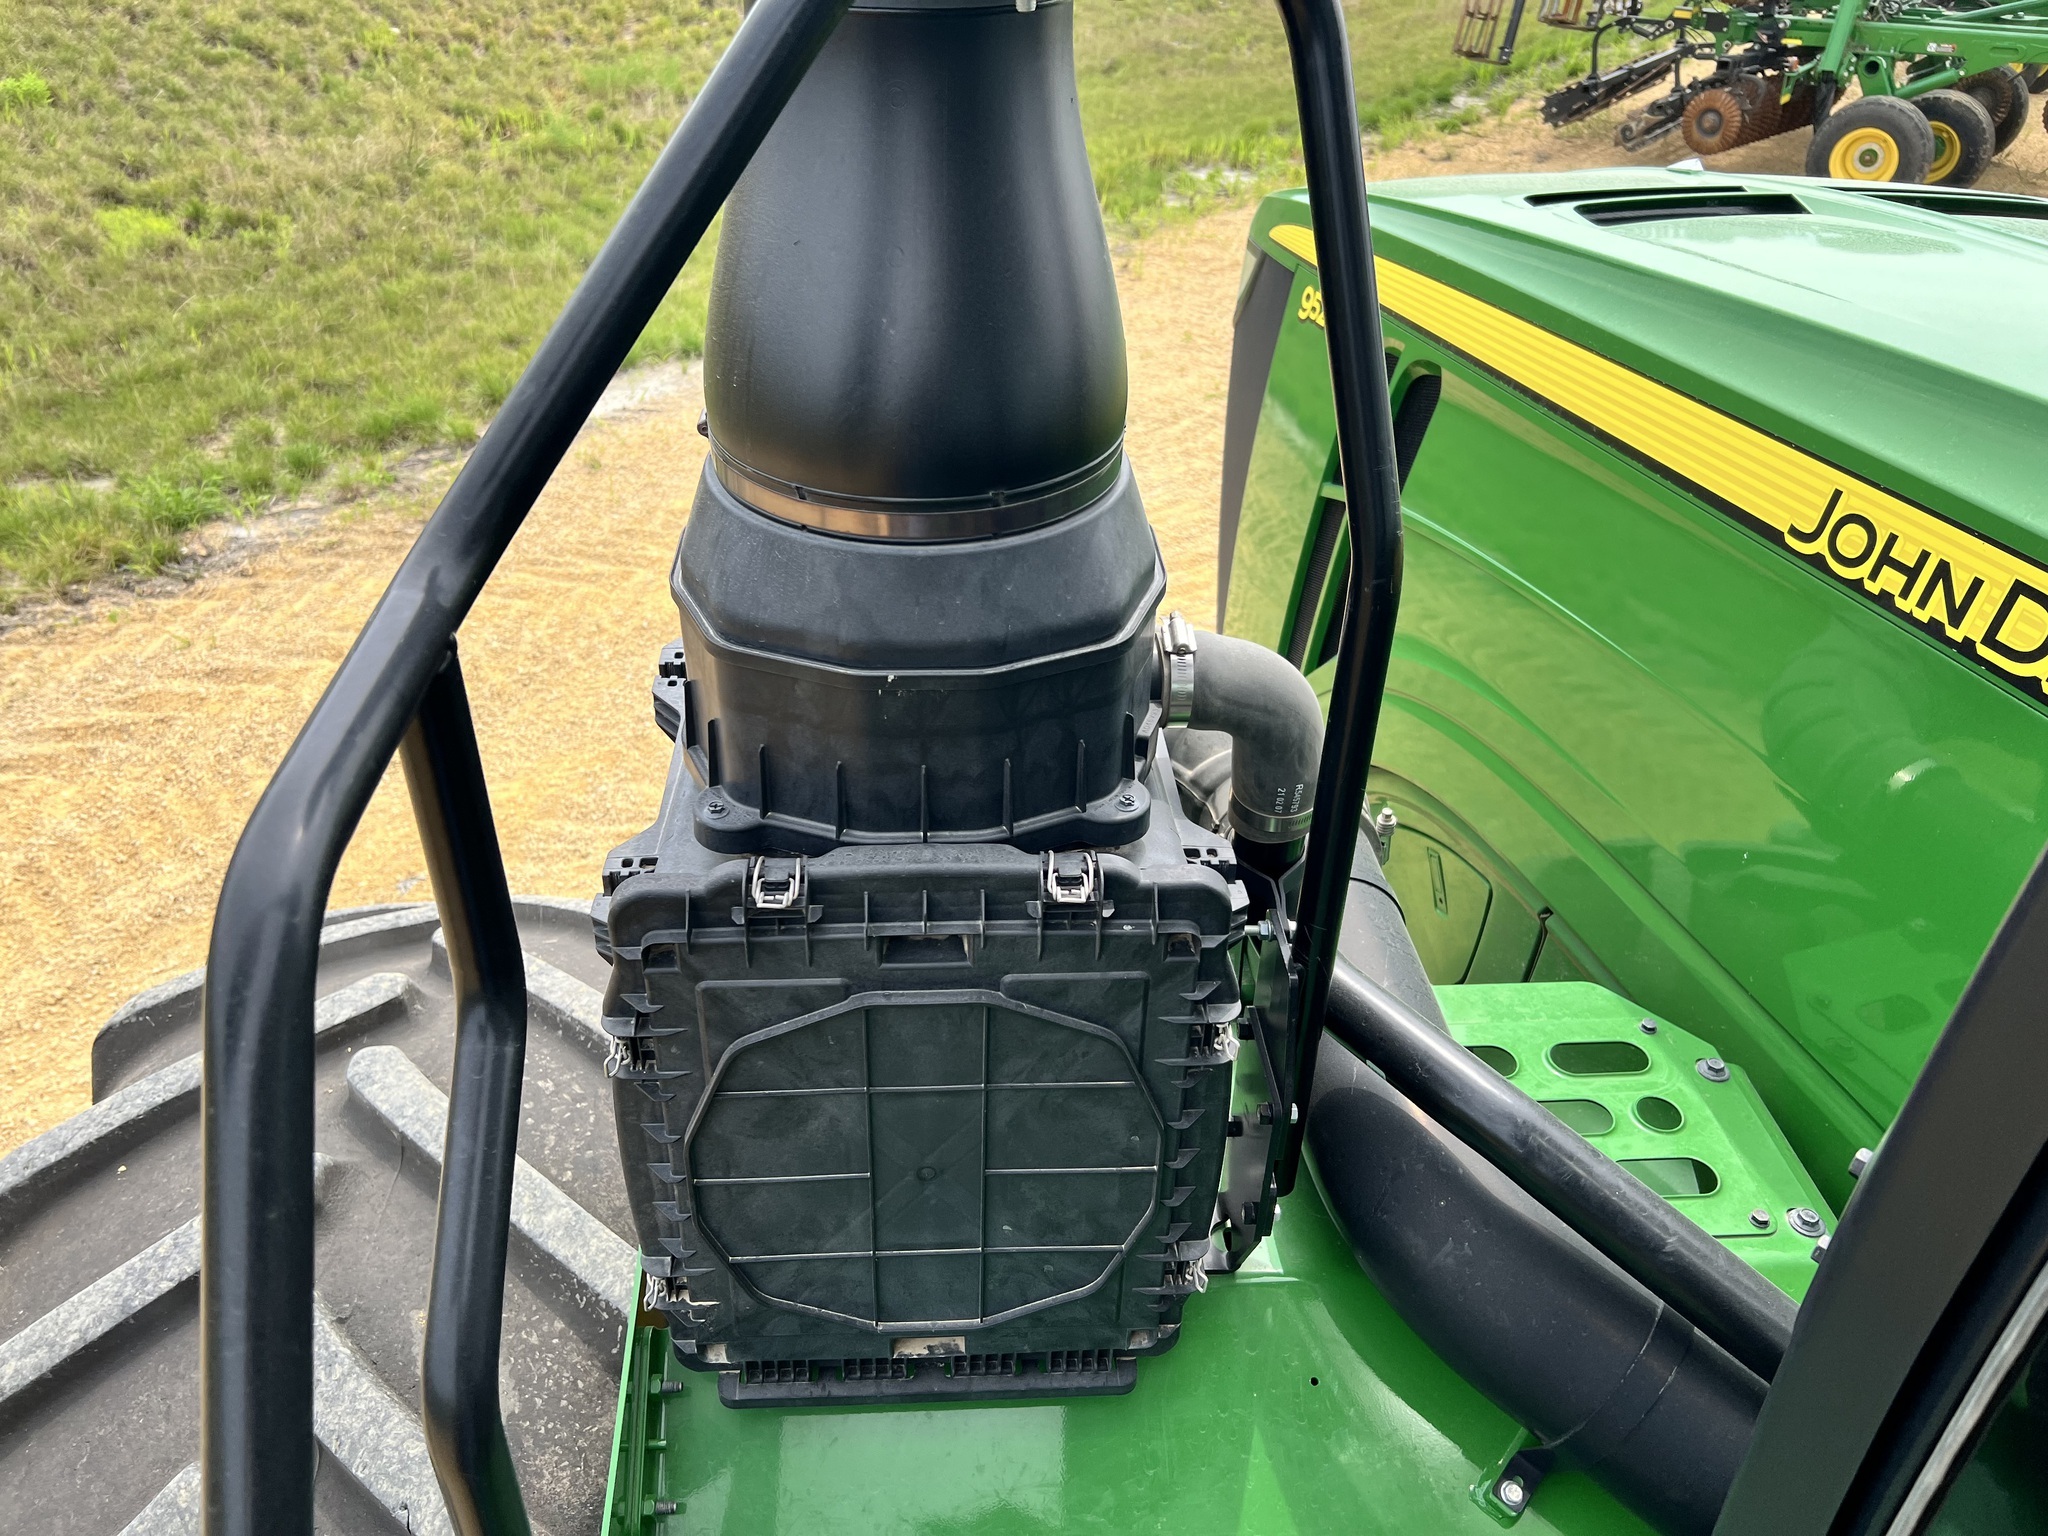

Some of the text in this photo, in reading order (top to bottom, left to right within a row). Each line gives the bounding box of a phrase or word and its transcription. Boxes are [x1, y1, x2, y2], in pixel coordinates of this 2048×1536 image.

[1785, 487, 2048, 683] JOHN D
[1277, 788, 1286, 796] 21
[1275, 797, 1284, 805] 02
